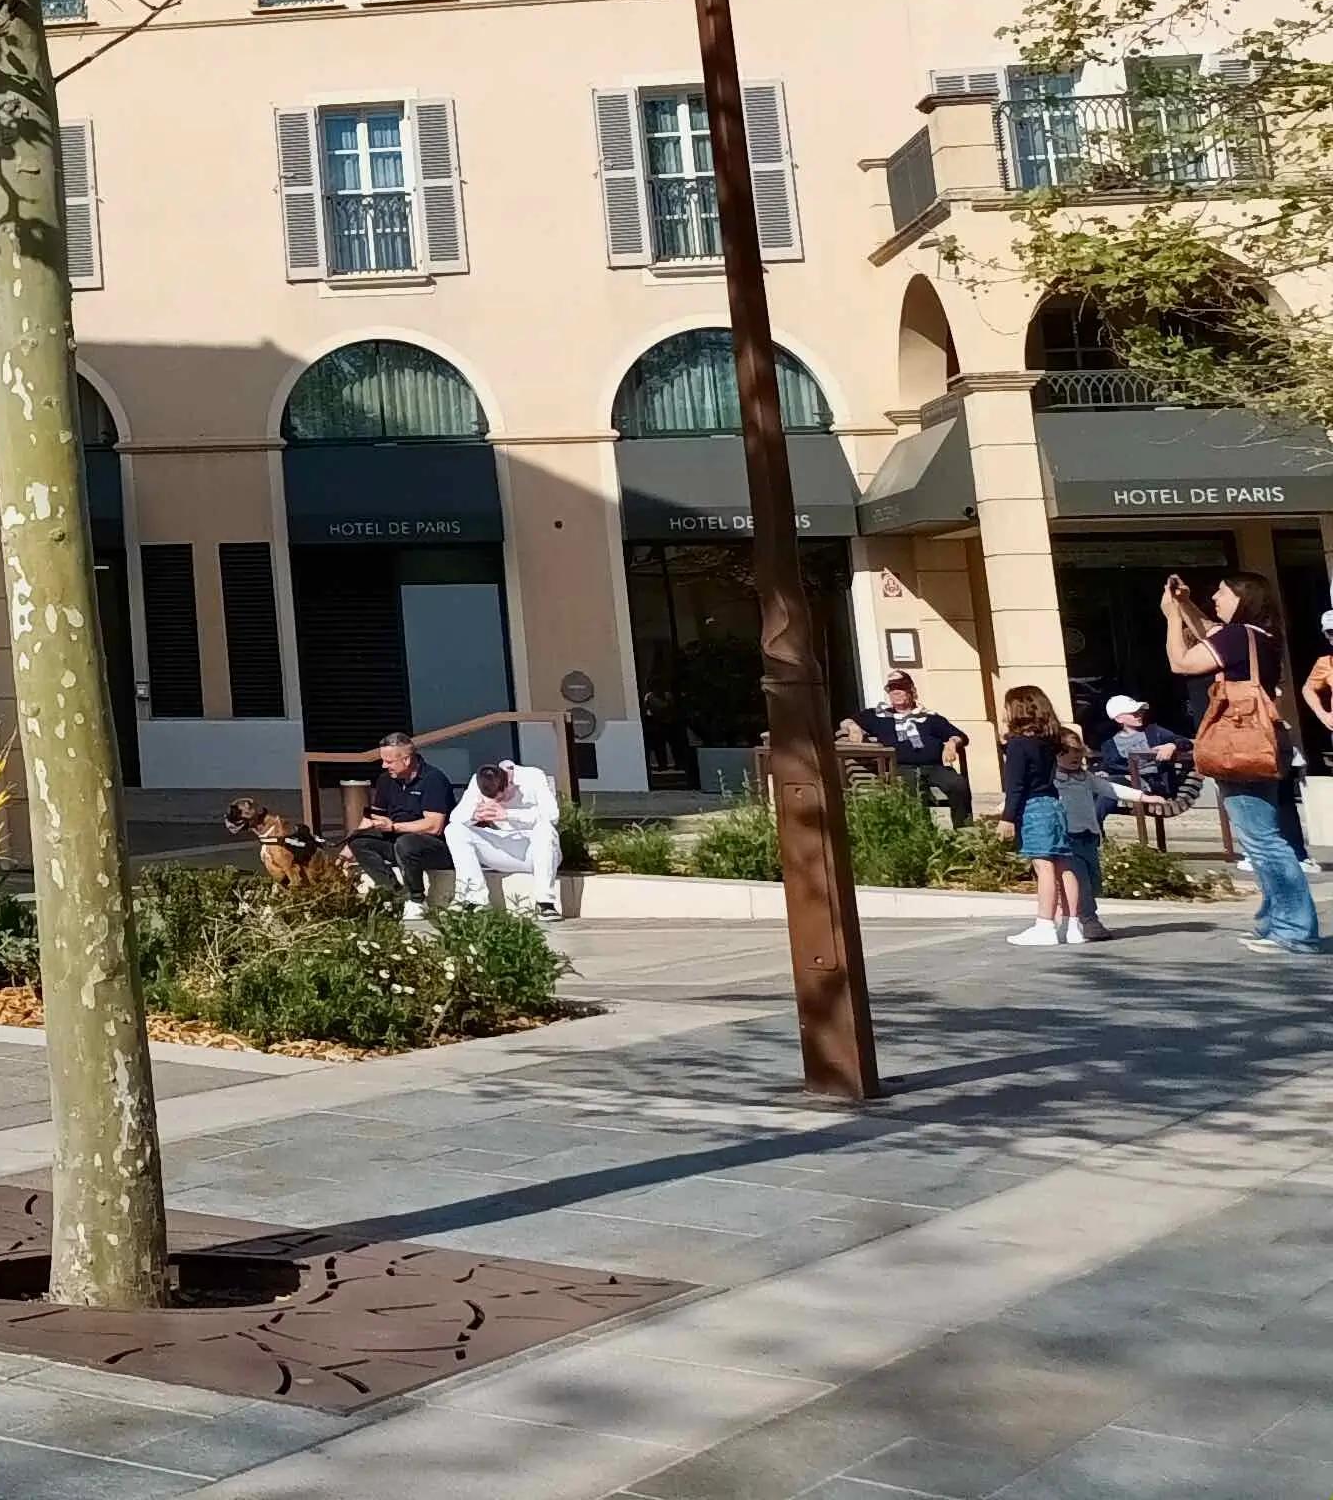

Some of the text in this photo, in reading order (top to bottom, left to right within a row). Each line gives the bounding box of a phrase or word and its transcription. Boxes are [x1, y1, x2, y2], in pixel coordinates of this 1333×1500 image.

[1113, 486, 1285, 505] HOTEL DE PARIS
[329, 520, 461, 536] HOTEL DE PARIS
[669, 514, 754, 531] HOTEL DE
